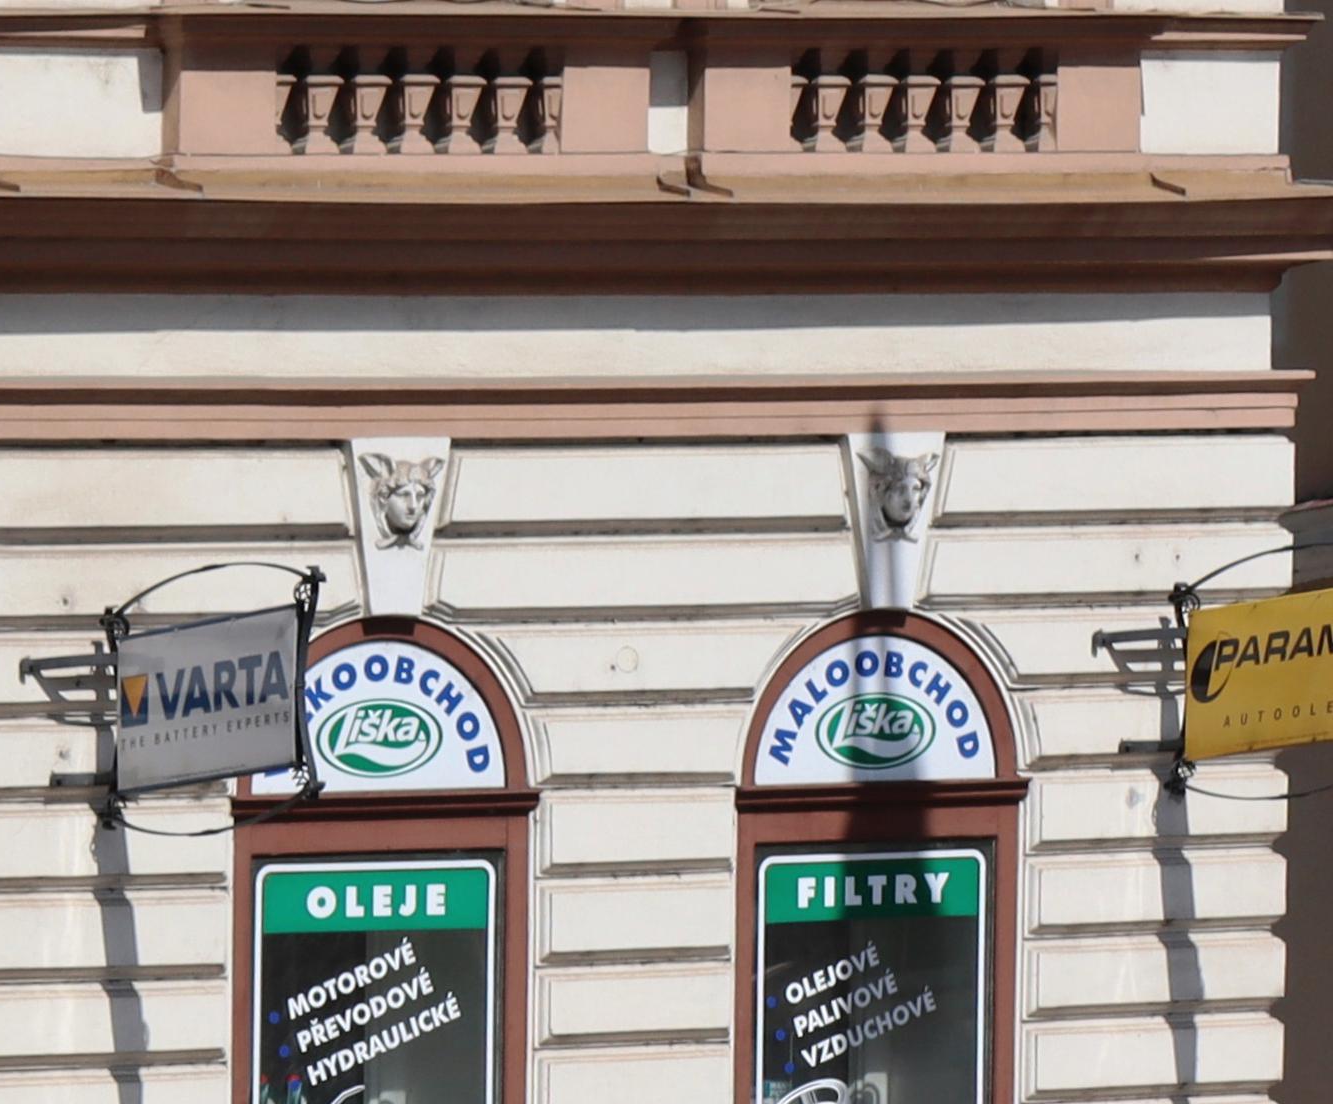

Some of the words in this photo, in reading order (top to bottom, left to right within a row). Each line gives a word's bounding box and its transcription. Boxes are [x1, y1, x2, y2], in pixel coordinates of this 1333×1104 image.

[155, 650, 289, 721] VARTA
[304, 654, 491, 774] KOOBCHOD
[769, 650, 980, 766] MALOOBCHOD
[121, 735, 145, 751] THE
[154, 723, 218, 745] BATTERY
[227, 711, 290, 733] EXPERTS
[334, 704, 431, 768] Liška
[833, 698, 922, 758] Liška
[306, 883, 447, 919] OLEJE
[797, 872, 951, 909] FILTRY
[287, 936, 417, 1020] MOTOROVÉ
[785, 940, 881, 1005] OLEJOVÉ
[793, 968, 899, 1039] PALIVOVÉ
[296, 966, 434, 1053] PŘEVODOVÉ
[307, 991, 462, 1087] HYDRAULICKÉ
[801, 985, 938, 1069] VZDUCHOVÉ
